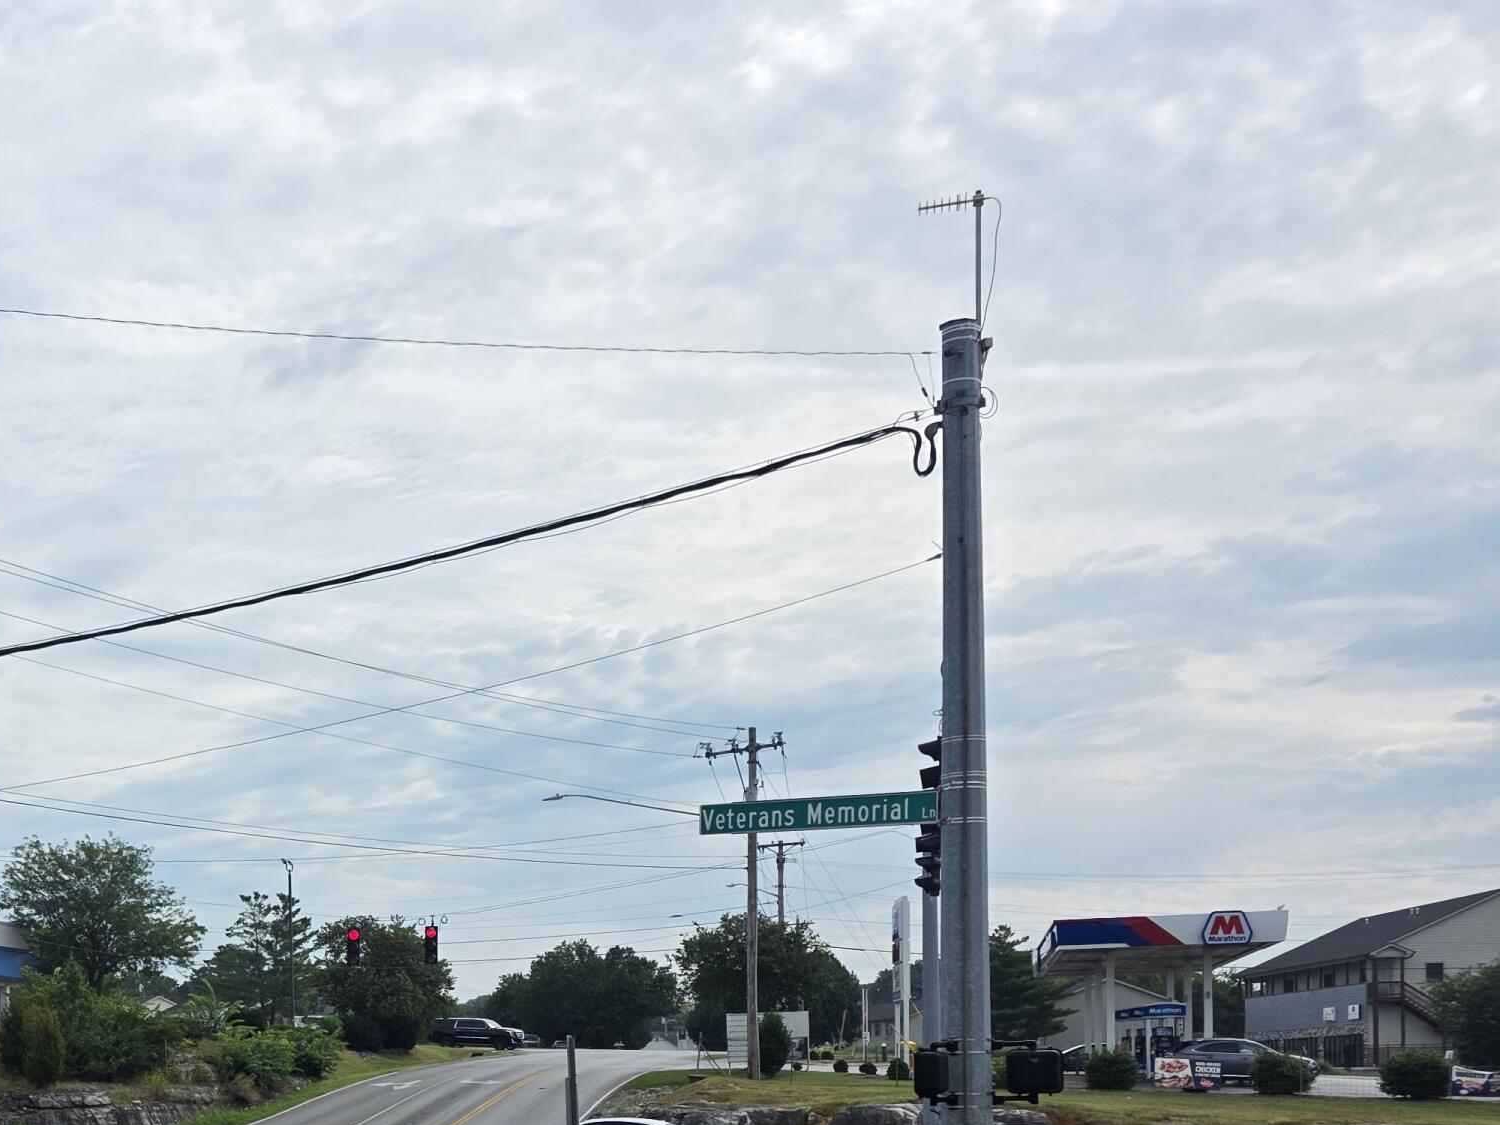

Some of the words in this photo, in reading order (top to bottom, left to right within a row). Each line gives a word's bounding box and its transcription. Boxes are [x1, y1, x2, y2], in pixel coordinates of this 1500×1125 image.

[702, 808, 795, 833] Veterans
[807, 798, 909, 826] Memorial
[922, 807, 936, 819] Ln
[1209, 915, 1245, 935] M
[1194, 1066, 1222, 1074] CHICKEN
